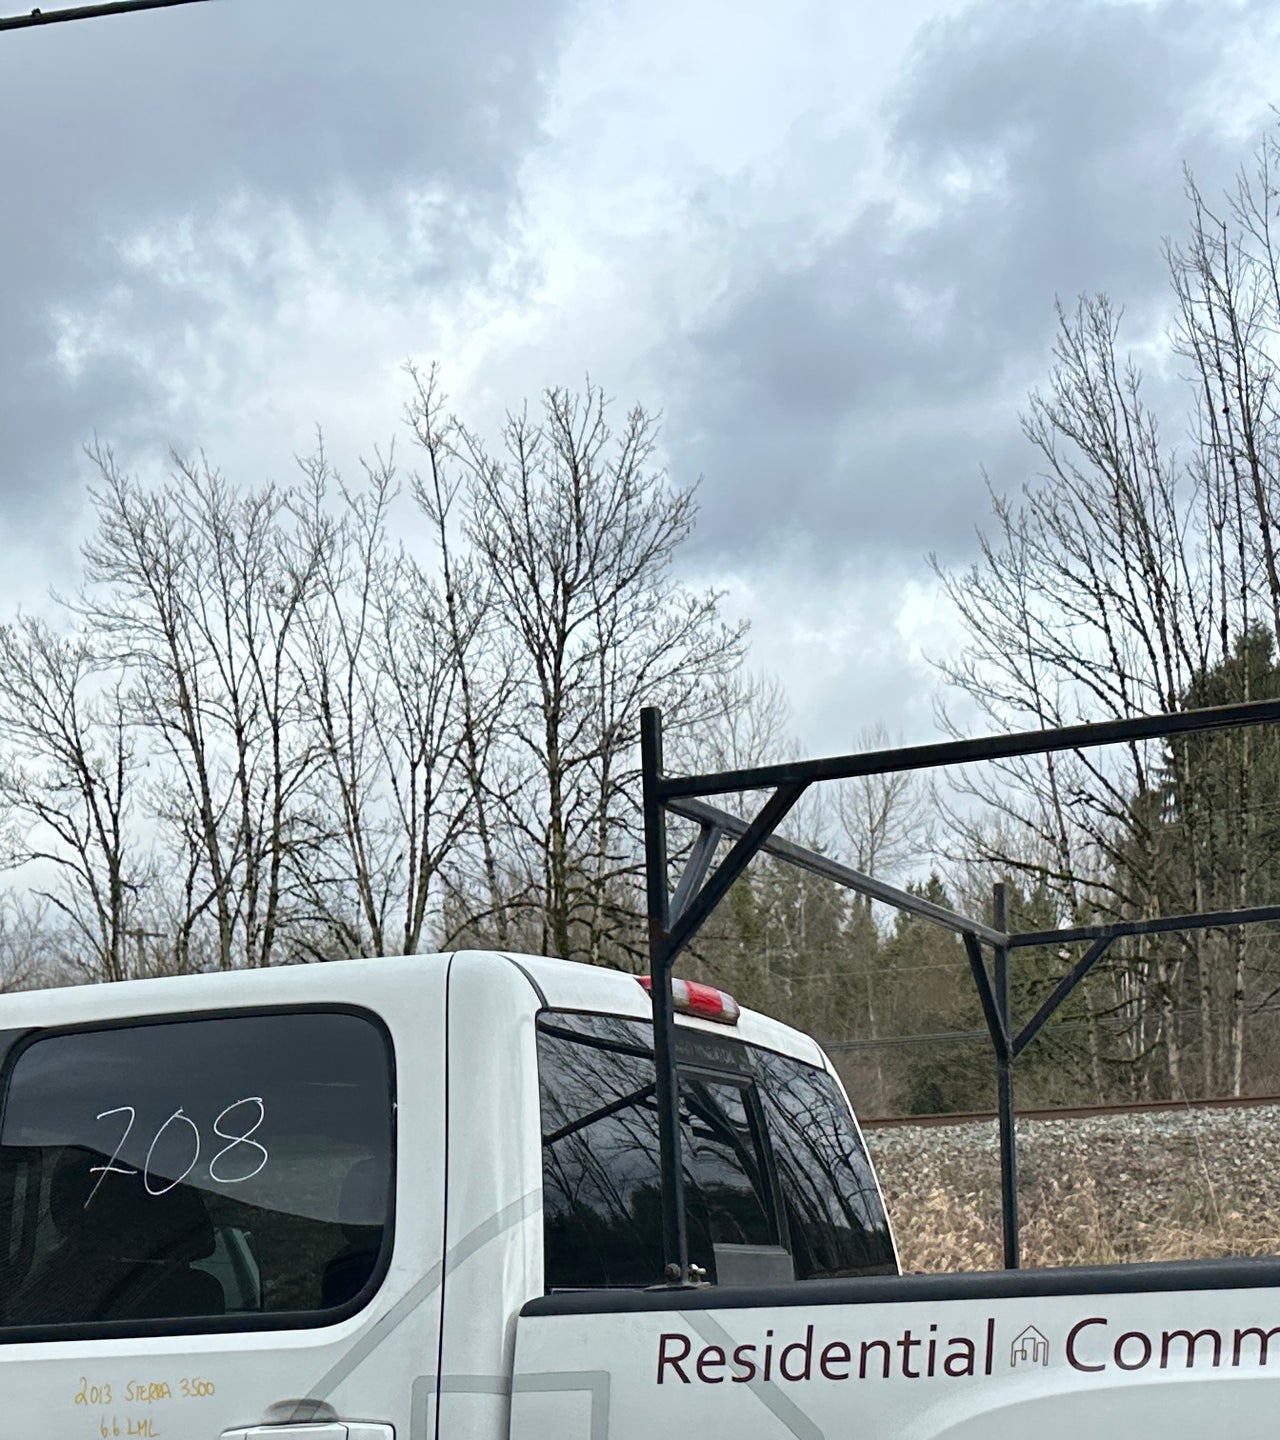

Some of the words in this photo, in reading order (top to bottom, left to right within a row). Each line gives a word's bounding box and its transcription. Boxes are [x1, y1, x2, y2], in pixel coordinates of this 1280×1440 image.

[84, 1097, 269, 1210] 708
[656, 1317, 995, 1386] Residential
[75, 1376, 113, 1406] 2013
[180, 1377, 216, 1399] 3500
